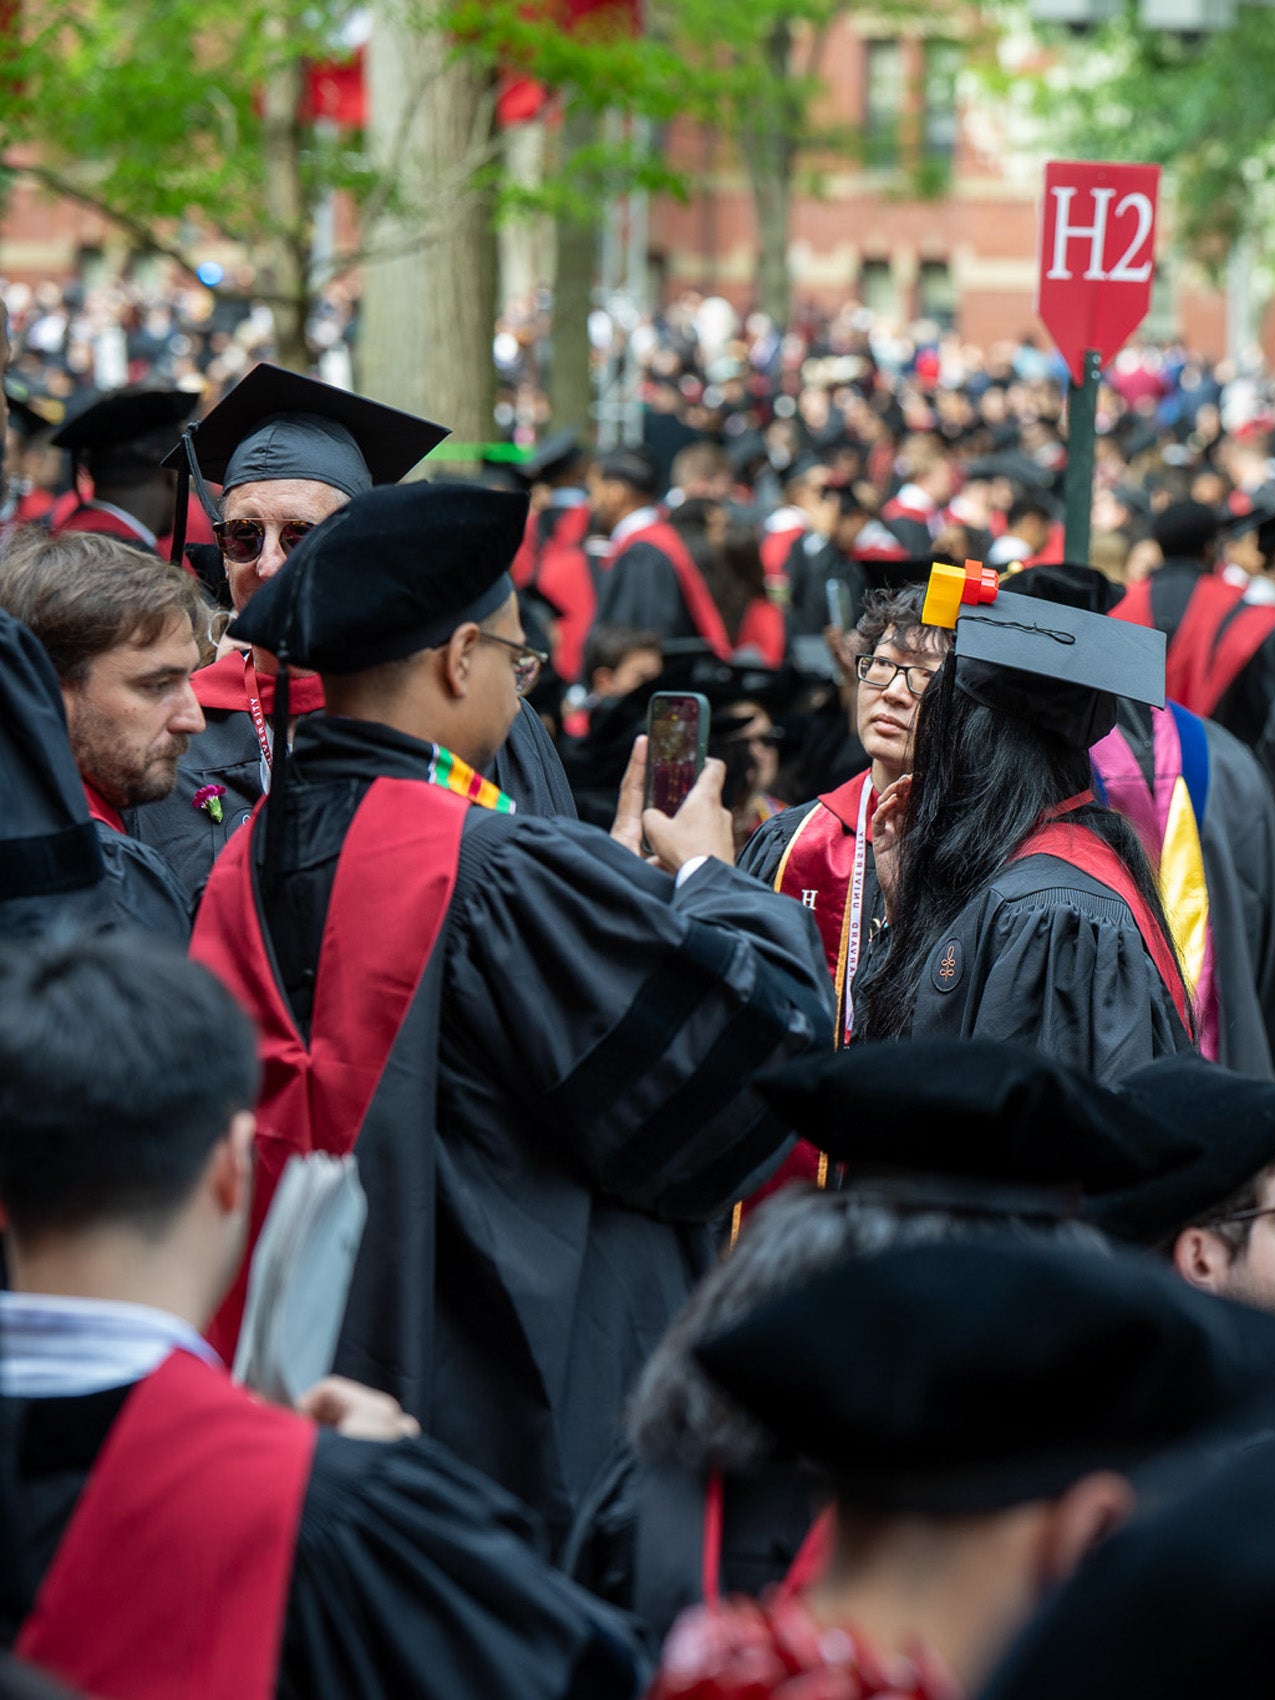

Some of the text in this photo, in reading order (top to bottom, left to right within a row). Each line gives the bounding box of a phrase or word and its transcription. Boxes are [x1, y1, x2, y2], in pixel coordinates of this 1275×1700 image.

[1046, 186, 1153, 283] H2
[250, 698, 272, 766] IVERSITY
[801, 889, 819, 910] H
